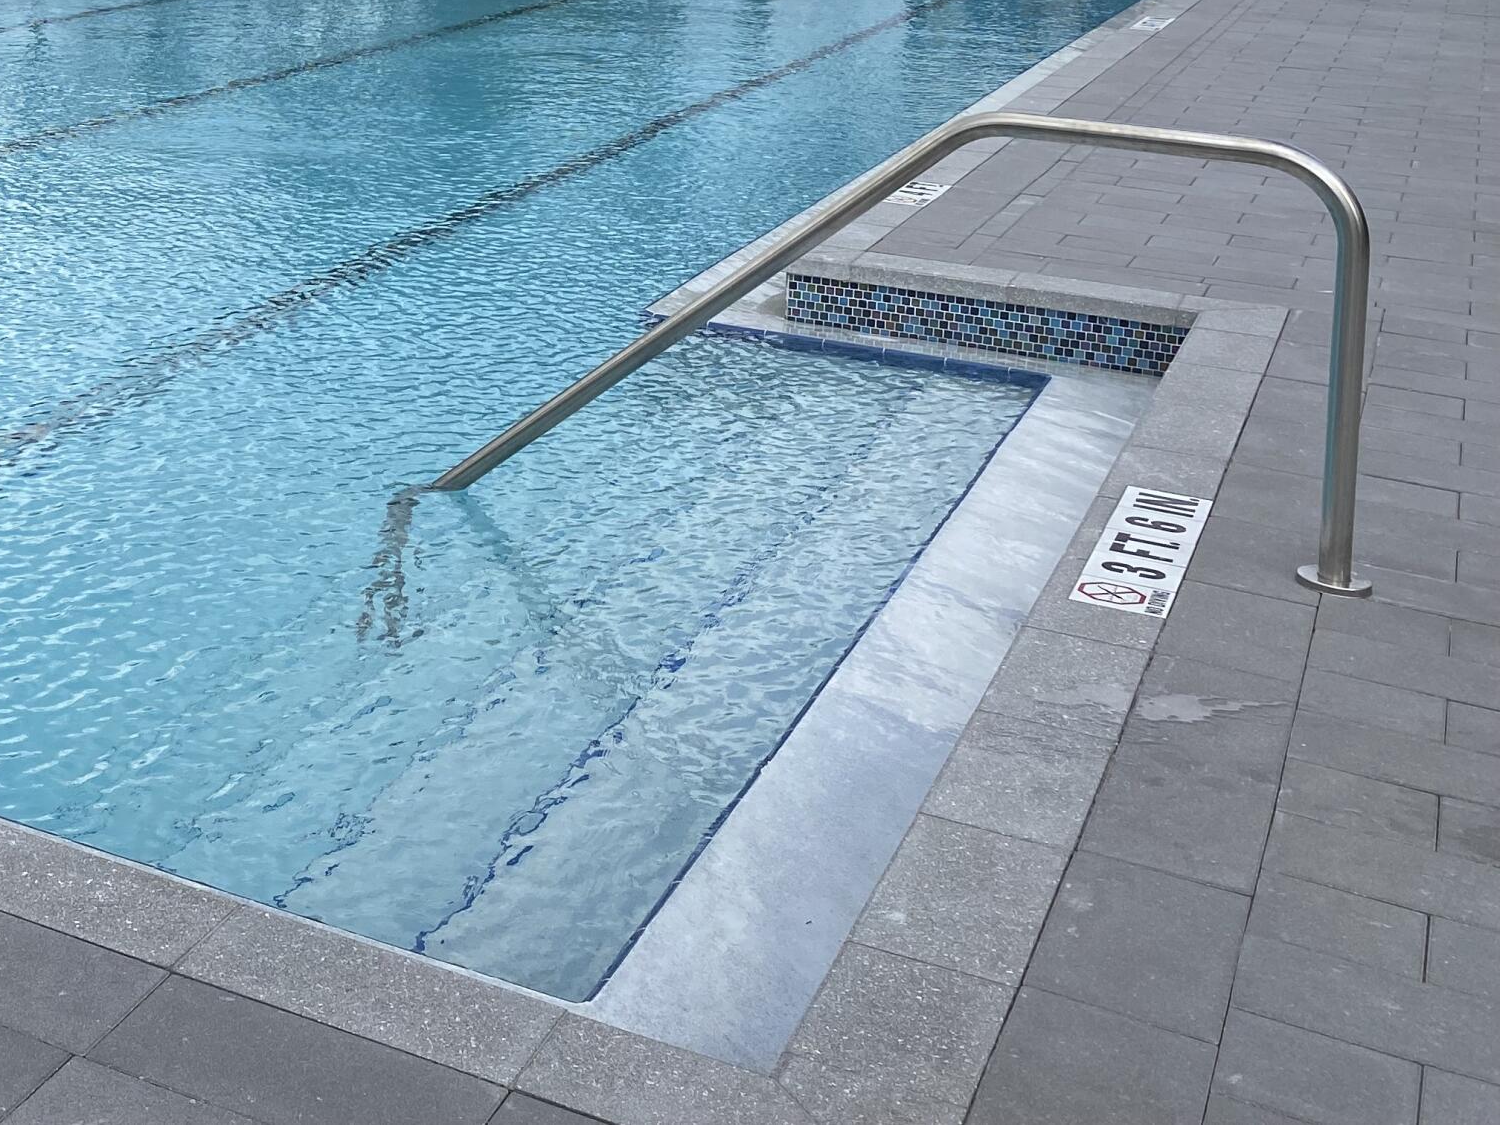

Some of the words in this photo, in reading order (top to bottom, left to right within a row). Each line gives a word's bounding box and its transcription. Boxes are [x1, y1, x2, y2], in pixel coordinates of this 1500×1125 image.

[1133, 492, 1200, 518] IN.
[1125, 516, 1187, 533] 6
[1109, 531, 1181, 563] FT.
[1101, 561, 1166, 580] 3
